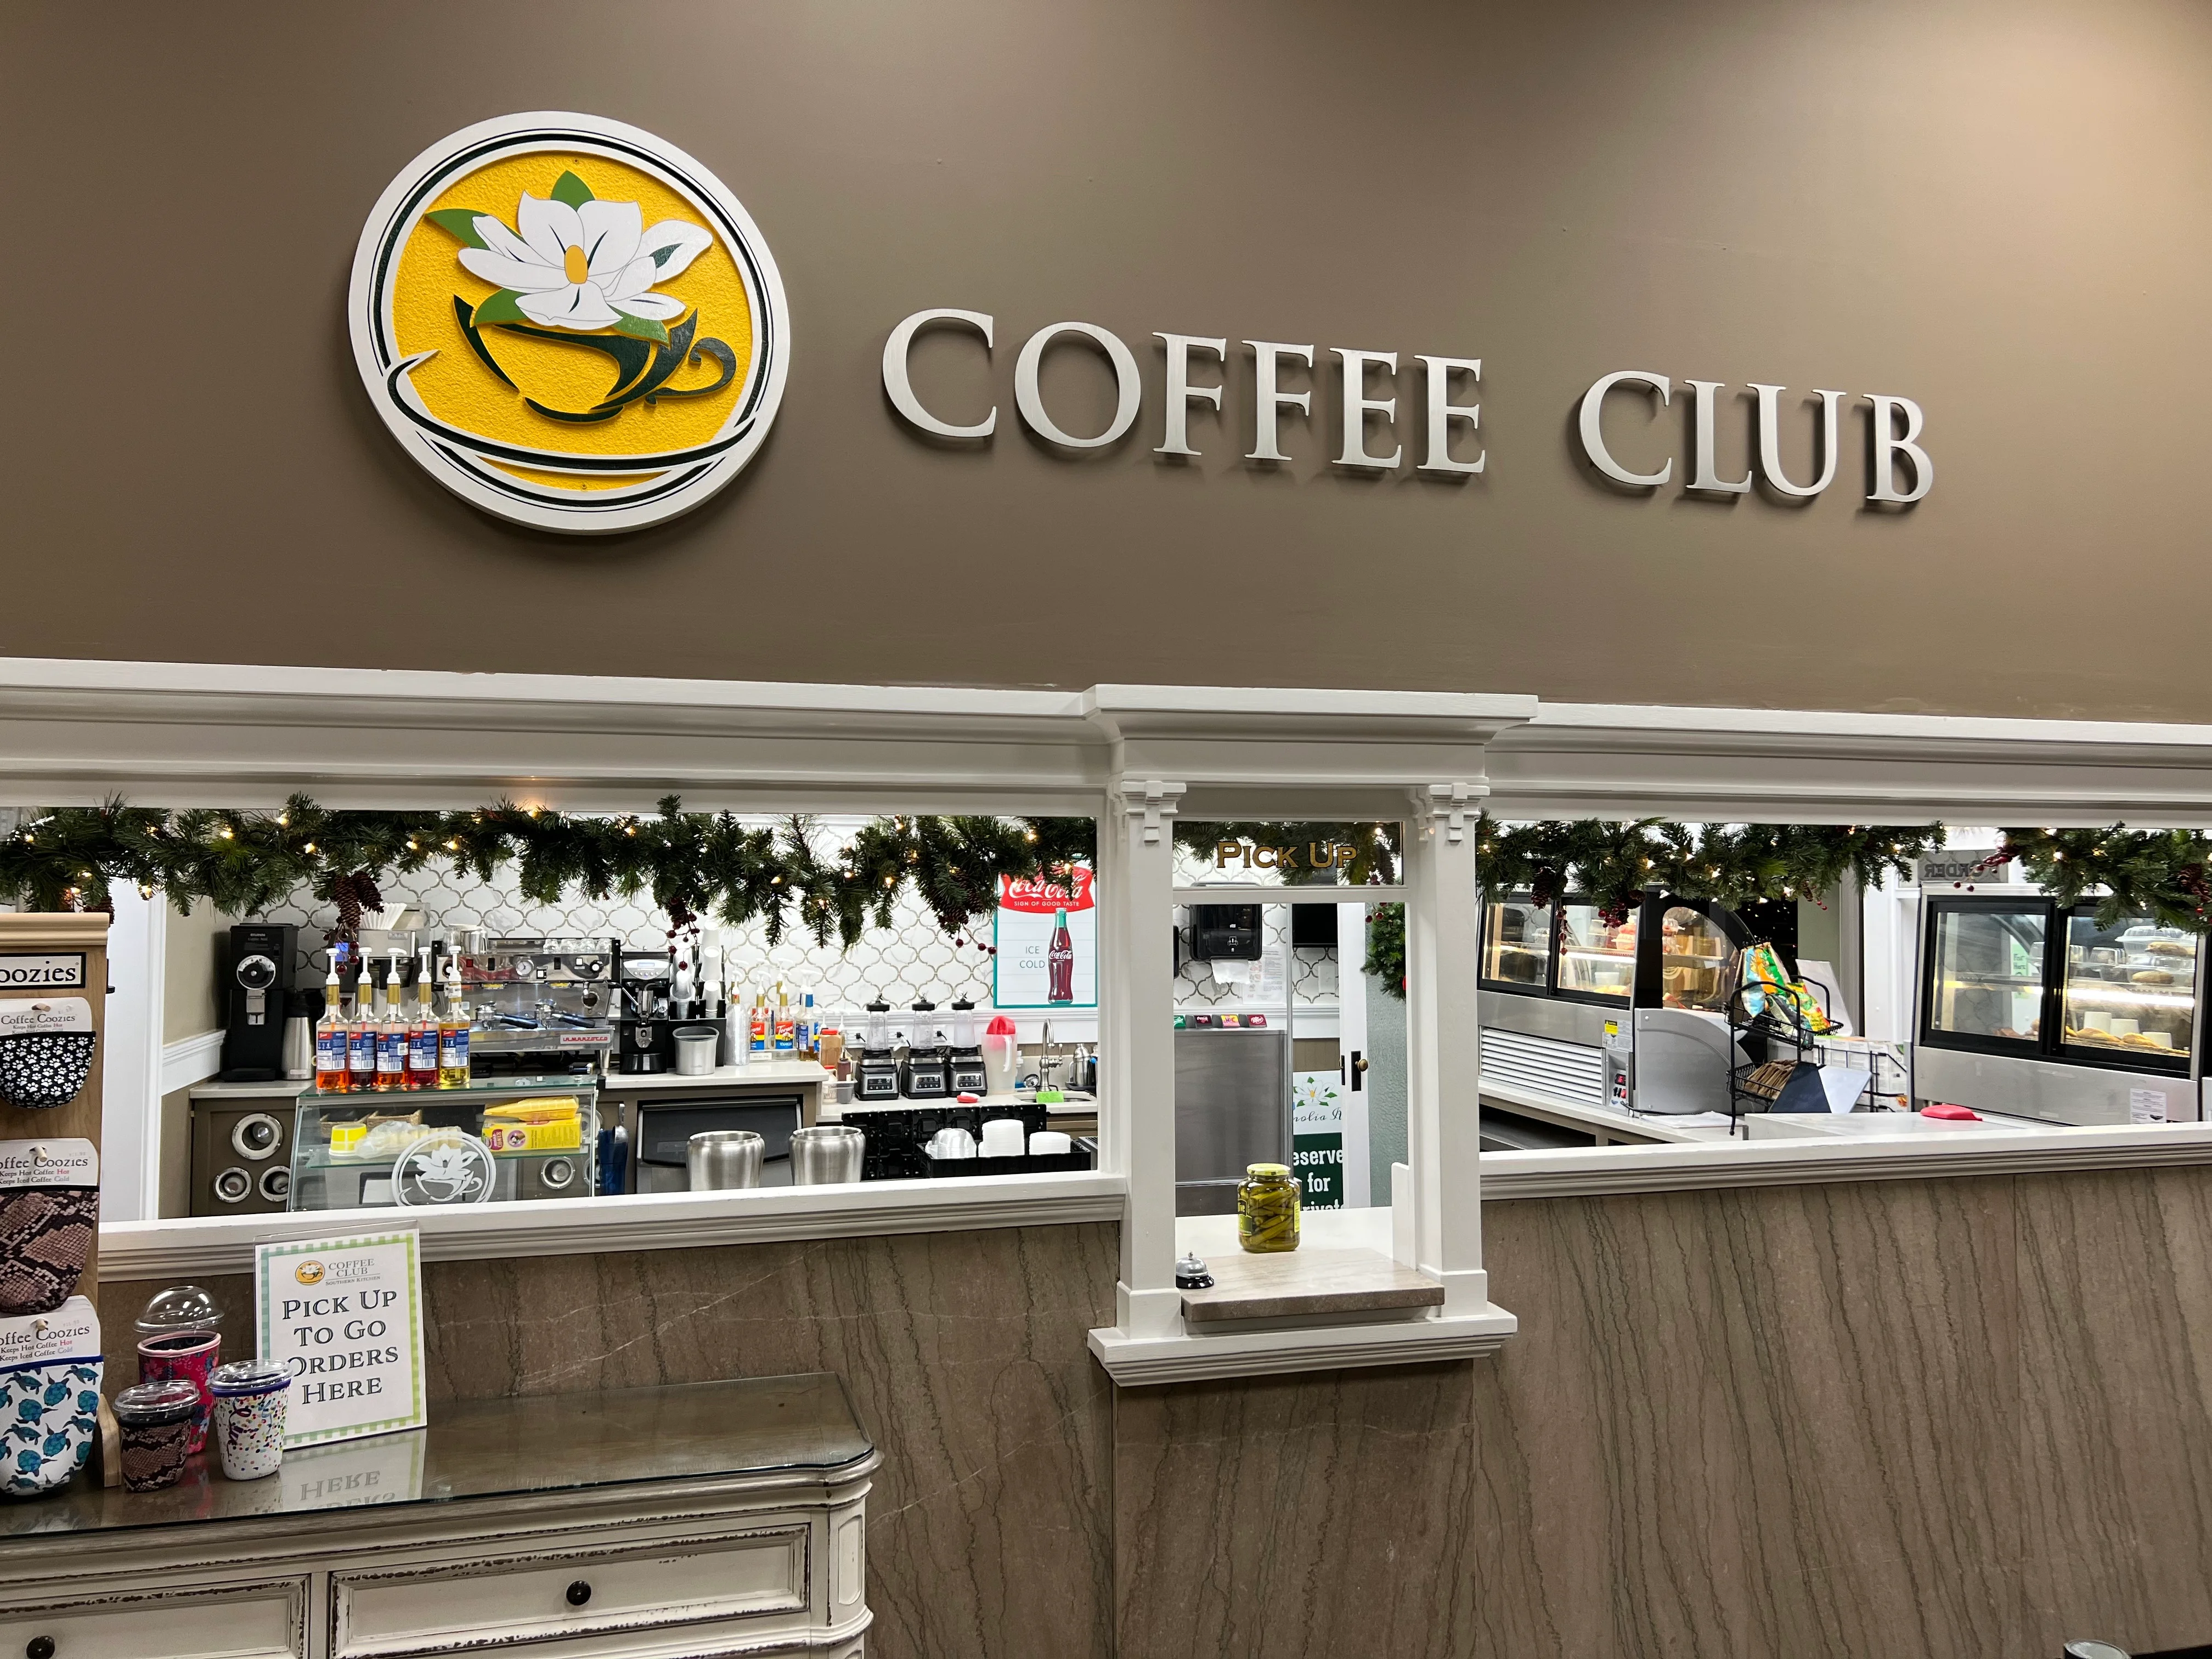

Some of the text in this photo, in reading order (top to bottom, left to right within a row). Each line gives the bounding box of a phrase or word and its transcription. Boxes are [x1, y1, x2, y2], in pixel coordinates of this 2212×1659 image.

[882, 308, 1934, 503] COFFEE CLUB
[1025, 946, 1040, 954] ICE
[1019, 960, 1045, 968] COLD
[1, 1014, 76, 1025] Coffee Coozies
[34, 1156, 88, 1167] Coozies
[1307, 1172, 1331, 1193] for
[329, 1259, 375, 1271] COFFEE
[336, 1267, 368, 1277] CLUB
[282, 1289, 397, 1320] PICK UP
[36, 1326, 90, 1341] Coozies
[294, 1320, 386, 1347] TO GO
[287, 1346, 399, 1377] ORDERS
[302, 1377, 382, 1405] HERE
